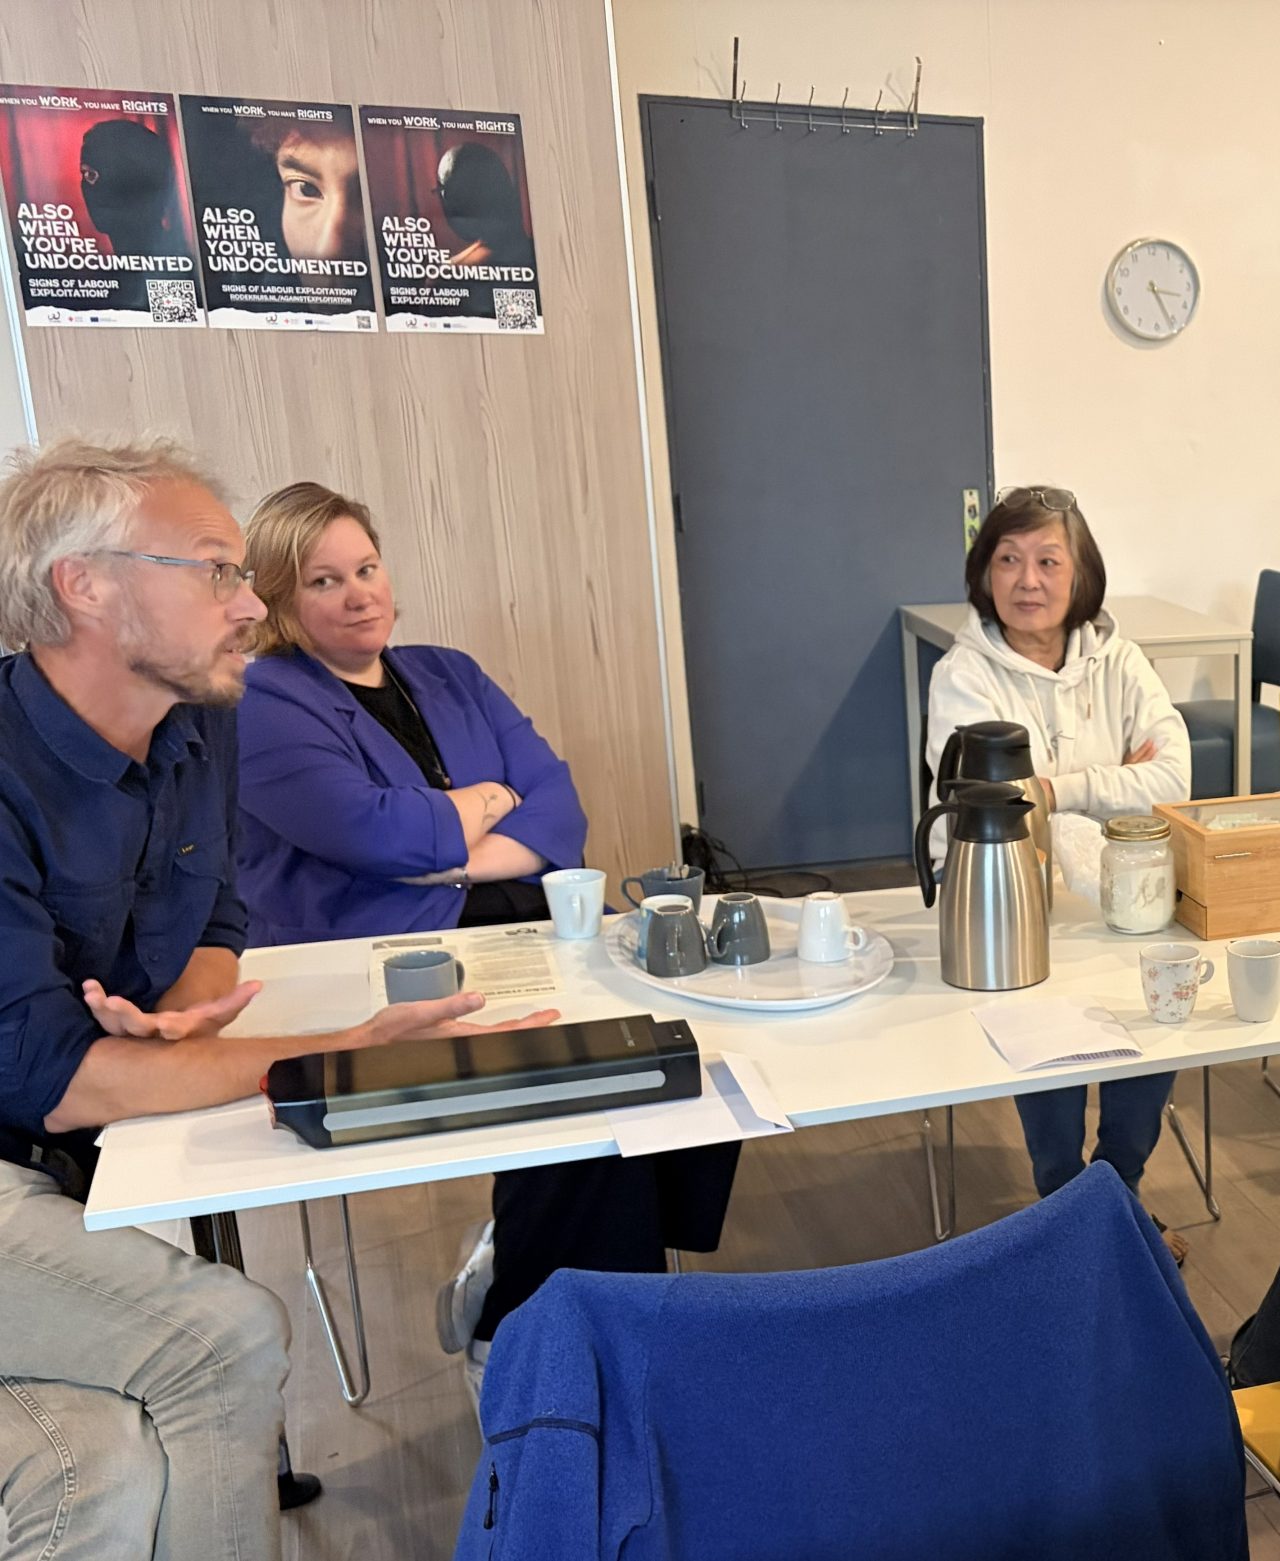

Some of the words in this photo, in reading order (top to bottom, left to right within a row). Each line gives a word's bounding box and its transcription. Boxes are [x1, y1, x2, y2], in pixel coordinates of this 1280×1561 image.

[21, 98, 38, 106] YOU
[39, 95, 82, 109] WORK,
[101, 103, 120, 111] HAVE
[122, 100, 168, 113] RIGHTS
[233, 105, 266, 117] WORK,
[297, 109, 333, 121] RIGHTS
[367, 117, 387, 125] WHEN
[388, 118, 402, 126] YOU
[403, 116, 440, 128] WORK,
[475, 120, 515, 133] RIGHTS
[17, 203, 73, 220] ALSO
[202, 208, 255, 224] ALSO
[18, 220, 79, 237] WHEN
[203, 224, 260, 241] WHEN
[382, 216, 431, 232] ALSO
[21, 236, 98, 254] YOU'RE
[382, 231, 436, 248] WHEN
[205, 240, 277, 257] YOU'RE
[385, 247, 451, 264] YOU'RE
[1147, 246, 1157, 256] 12
[24, 253, 193, 272] UNDOCUMENTED
[208, 256, 368, 276] UNDOCUMENTED
[1131, 253, 1138, 263] 11
[387, 263, 534, 282] UNDOCUMENTED
[1119, 267, 1130, 277] 10
[28, 279, 60, 287] SIGNS
[78, 280, 119, 289] LABOUR
[222, 285, 247, 293] SIGNS
[261, 286, 294, 294] LABOUR
[296, 287, 357, 297] EXPLOITATION?
[390, 287, 417, 296] SIGNS
[418, 288, 431, 296] OF
[433, 288, 469, 297] LABOUR
[30, 288, 109, 298] EXPLOITATION?
[392, 296, 461, 306] EXPLOITATION?
